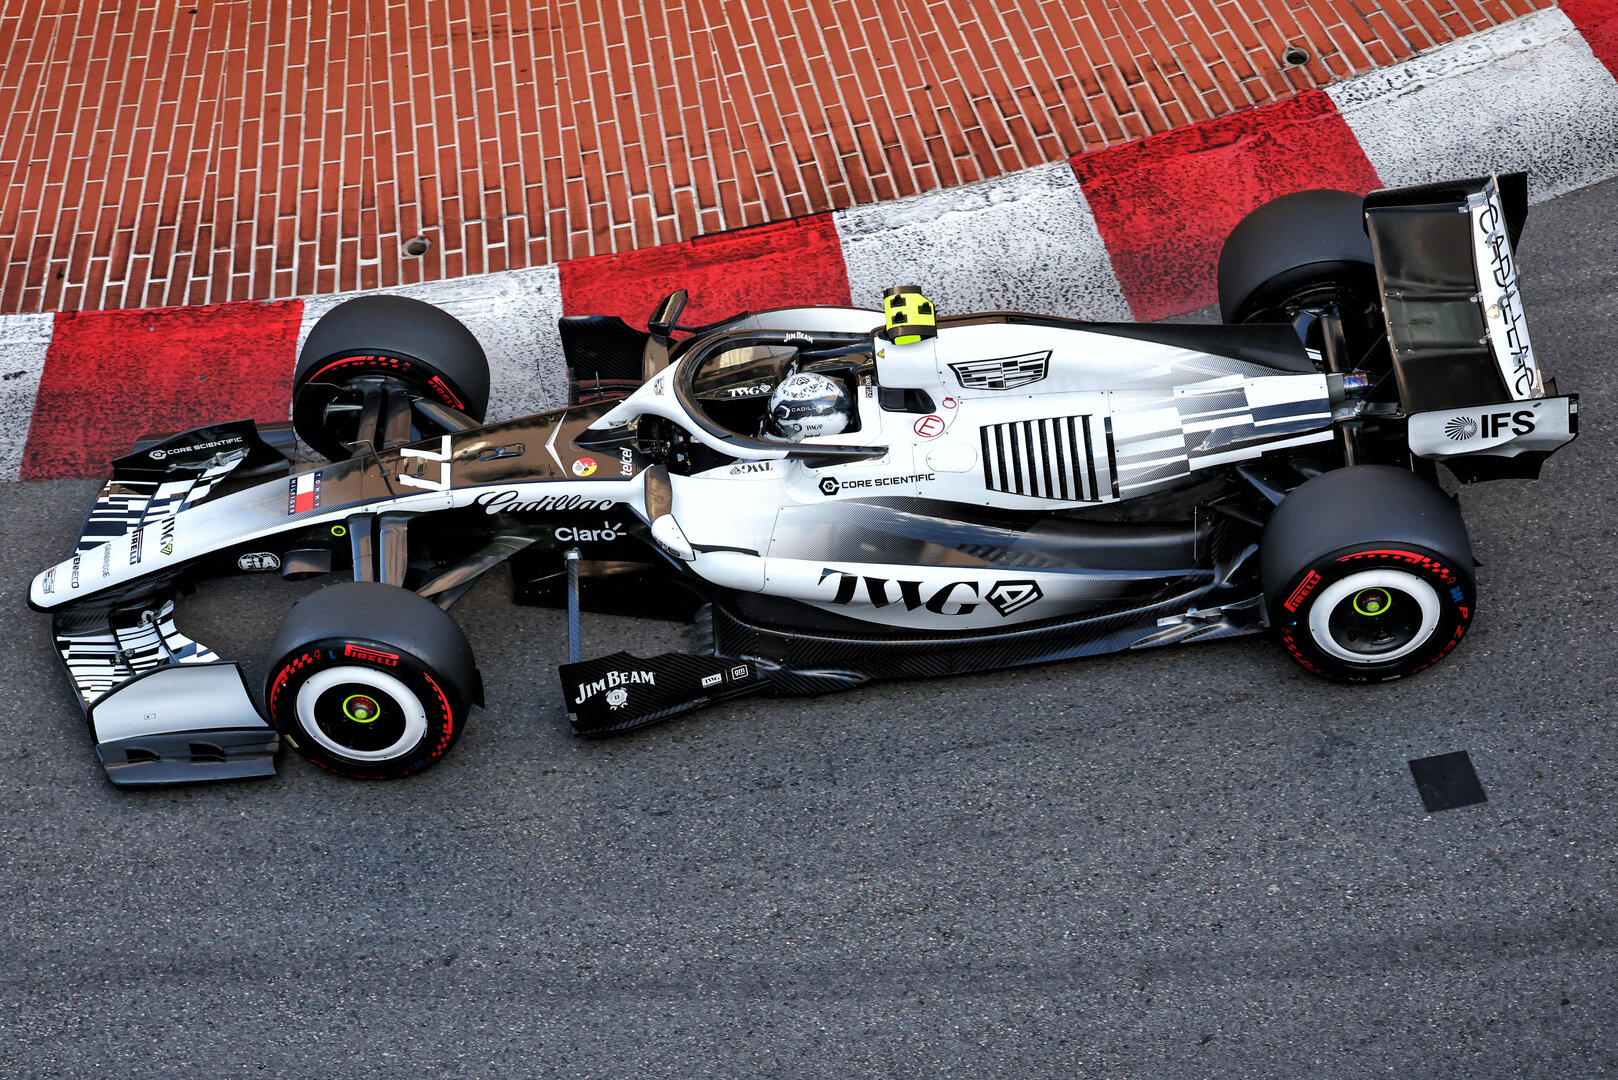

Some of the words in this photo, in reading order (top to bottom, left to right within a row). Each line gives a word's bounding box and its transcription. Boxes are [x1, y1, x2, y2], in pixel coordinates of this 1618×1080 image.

[1479, 203, 1535, 397] CADILLAC
[783, 332, 796, 344] JIM
[796, 331, 814, 344] BEAM
[728, 386, 760, 398] TWG
[1481, 410, 1535, 439] IFS
[167, 445, 193, 456] CORE
[194, 436, 242, 451] SCIENTIFIC
[619, 446, 633, 477] telcel
[841, 478, 873, 489] CORE
[875, 473, 936, 487] SCIENTIFIC
[289, 479, 297, 514] HILFIGER
[476, 490, 616, 515] Cadillac
[129, 527, 144, 566] PIRELLI
[554, 524, 618, 542] Claro
[817, 567, 981, 616] TWG
[1283, 569, 1323, 612] PIRELLI
[344, 644, 400, 667] PIRELLI
[575, 677, 607, 704] JIM
[606, 670, 656, 689] BEAM
